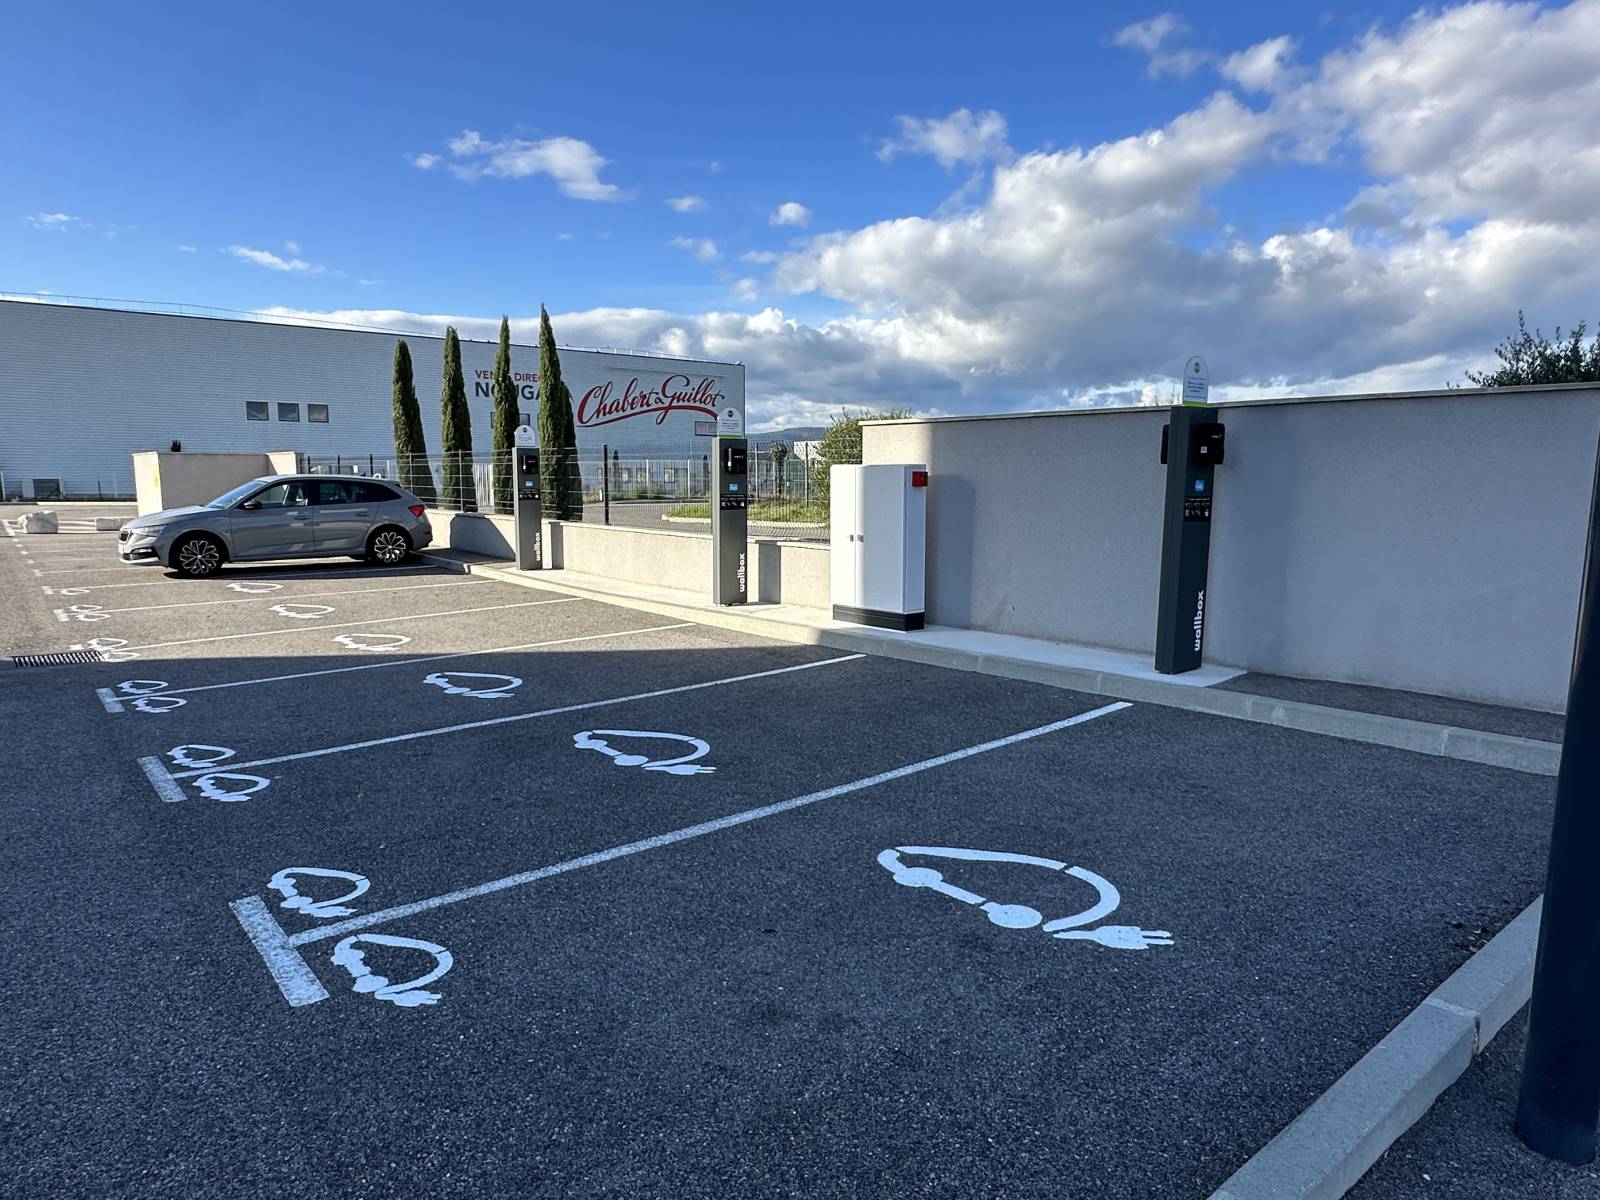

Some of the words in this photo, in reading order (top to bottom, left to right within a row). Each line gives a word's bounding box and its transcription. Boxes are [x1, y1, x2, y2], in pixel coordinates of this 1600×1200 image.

[514, 372, 541, 383] DIRE
[577, 377, 659, 425] Chabert
[656, 374, 725, 425] Guillot
[737, 553, 745, 592] wallbox
[1193, 589, 1204, 651] wallbox
